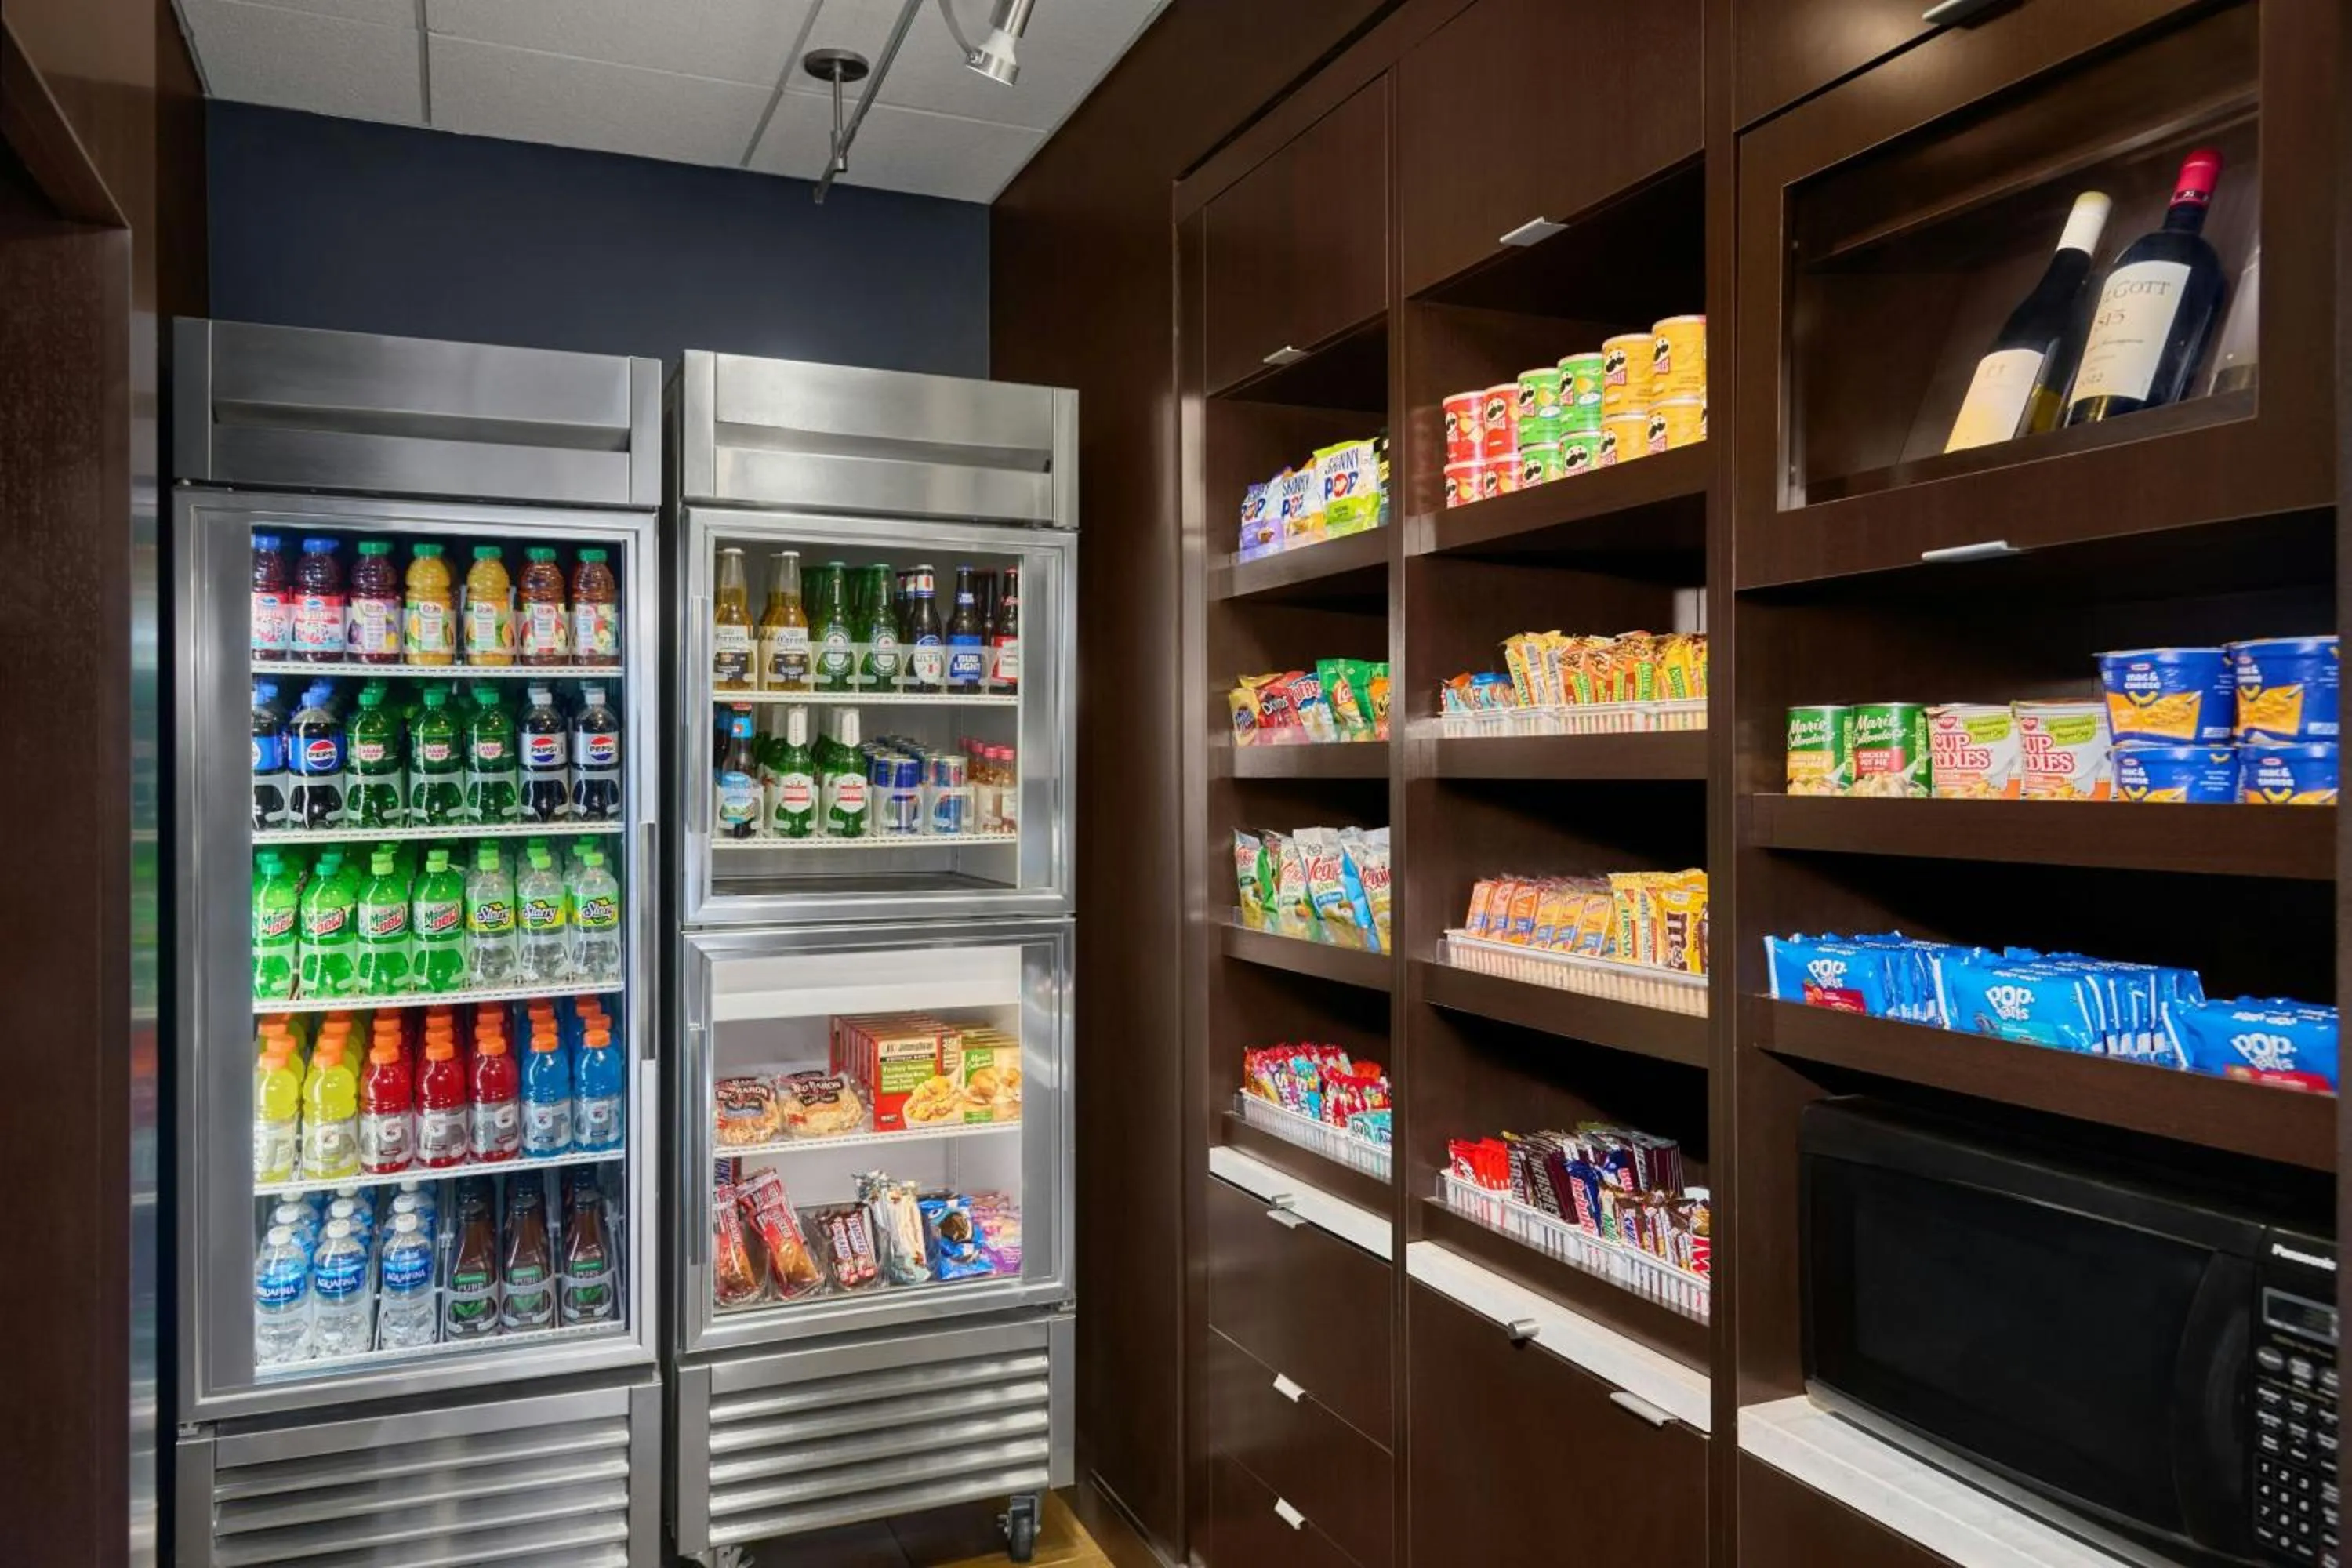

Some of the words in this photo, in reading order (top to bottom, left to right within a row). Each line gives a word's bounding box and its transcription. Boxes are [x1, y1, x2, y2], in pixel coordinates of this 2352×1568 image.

[2112, 280, 2170, 299] GOTT
[1324, 472, 1359, 500] POP
[1857, 714, 1900, 731] Marie
[1934, 735, 1969, 750] CUP
[2025, 736, 2053, 753] UP
[387, 1268, 426, 1283] AQUAFINA
